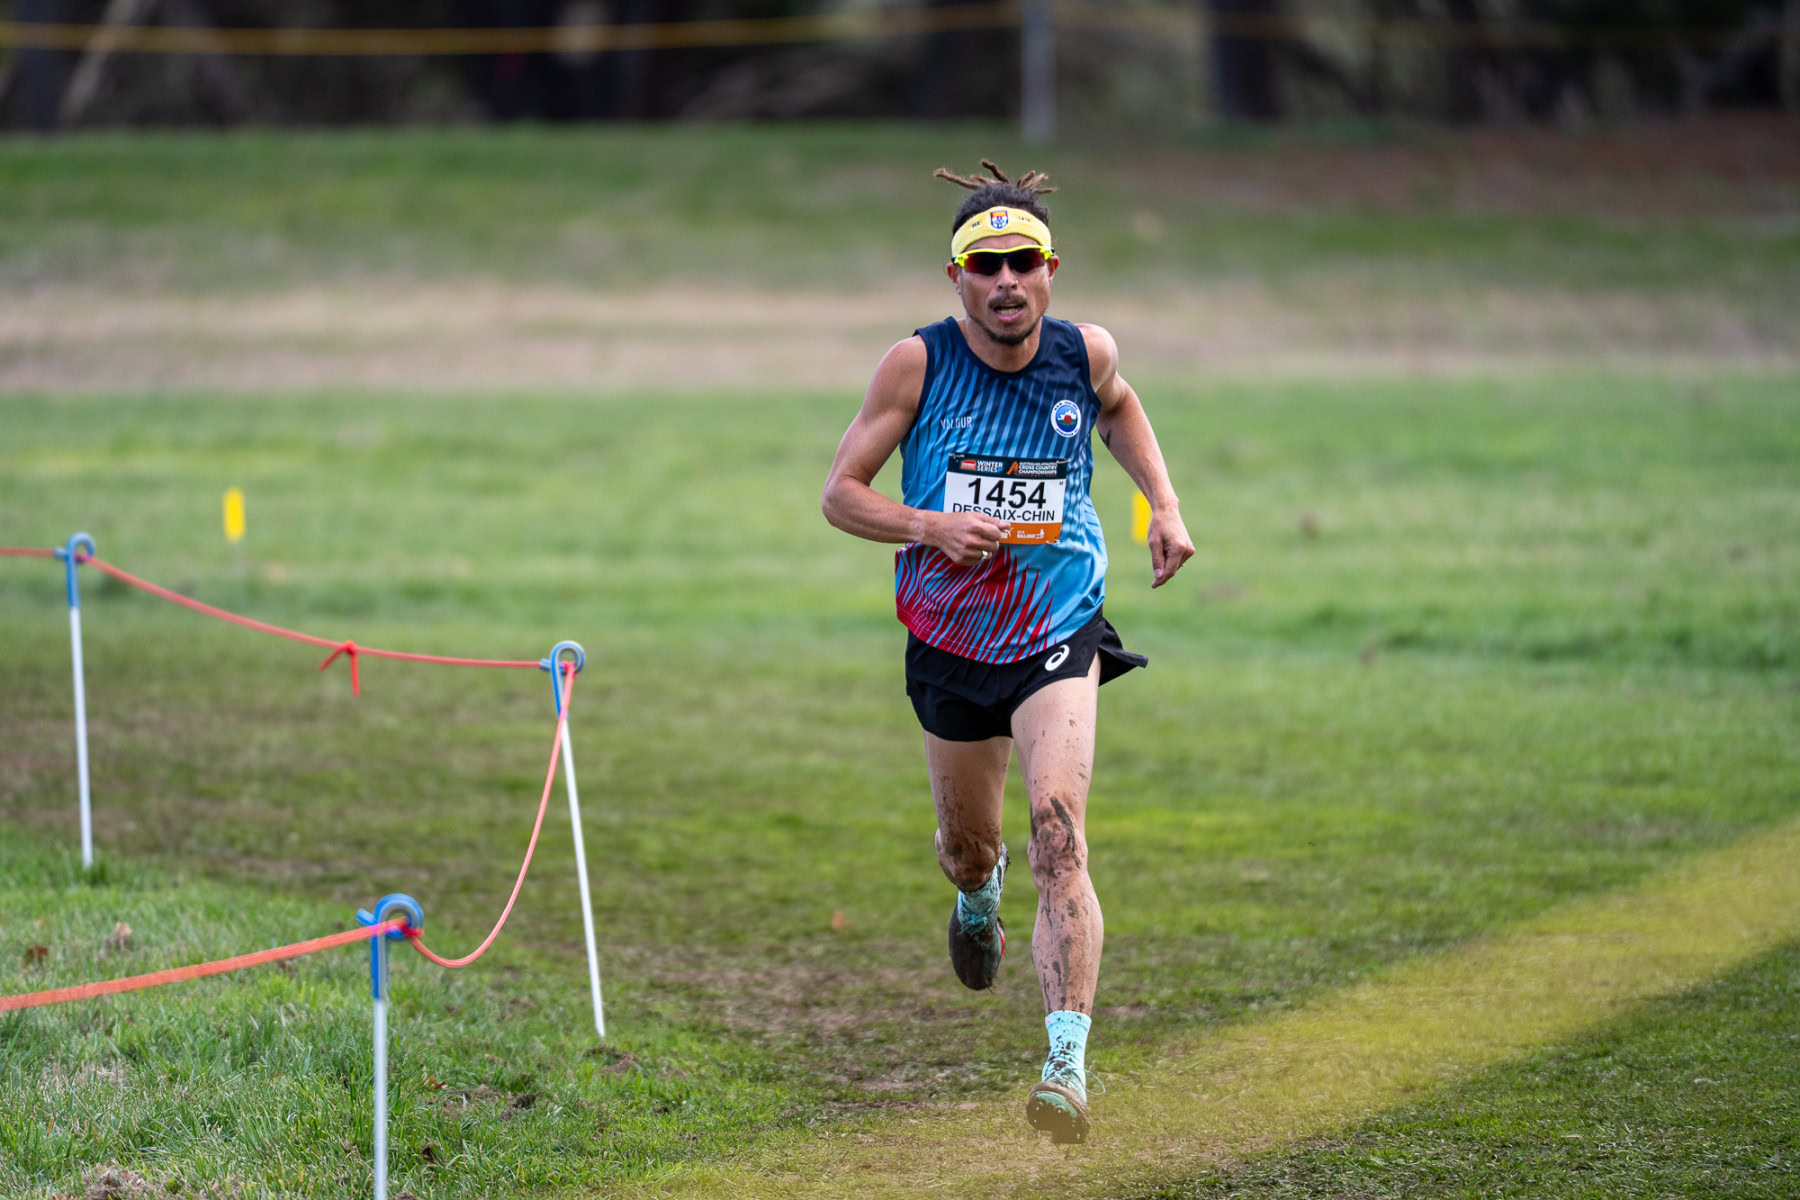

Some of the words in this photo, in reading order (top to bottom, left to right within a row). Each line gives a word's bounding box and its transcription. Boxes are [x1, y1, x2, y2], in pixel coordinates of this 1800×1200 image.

[940, 416, 972, 430] VALOUR
[977, 460, 1003, 469] WINTER
[968, 478, 1046, 509] 1454
[952, 503, 1055, 522] DESSAIX-CHIN
